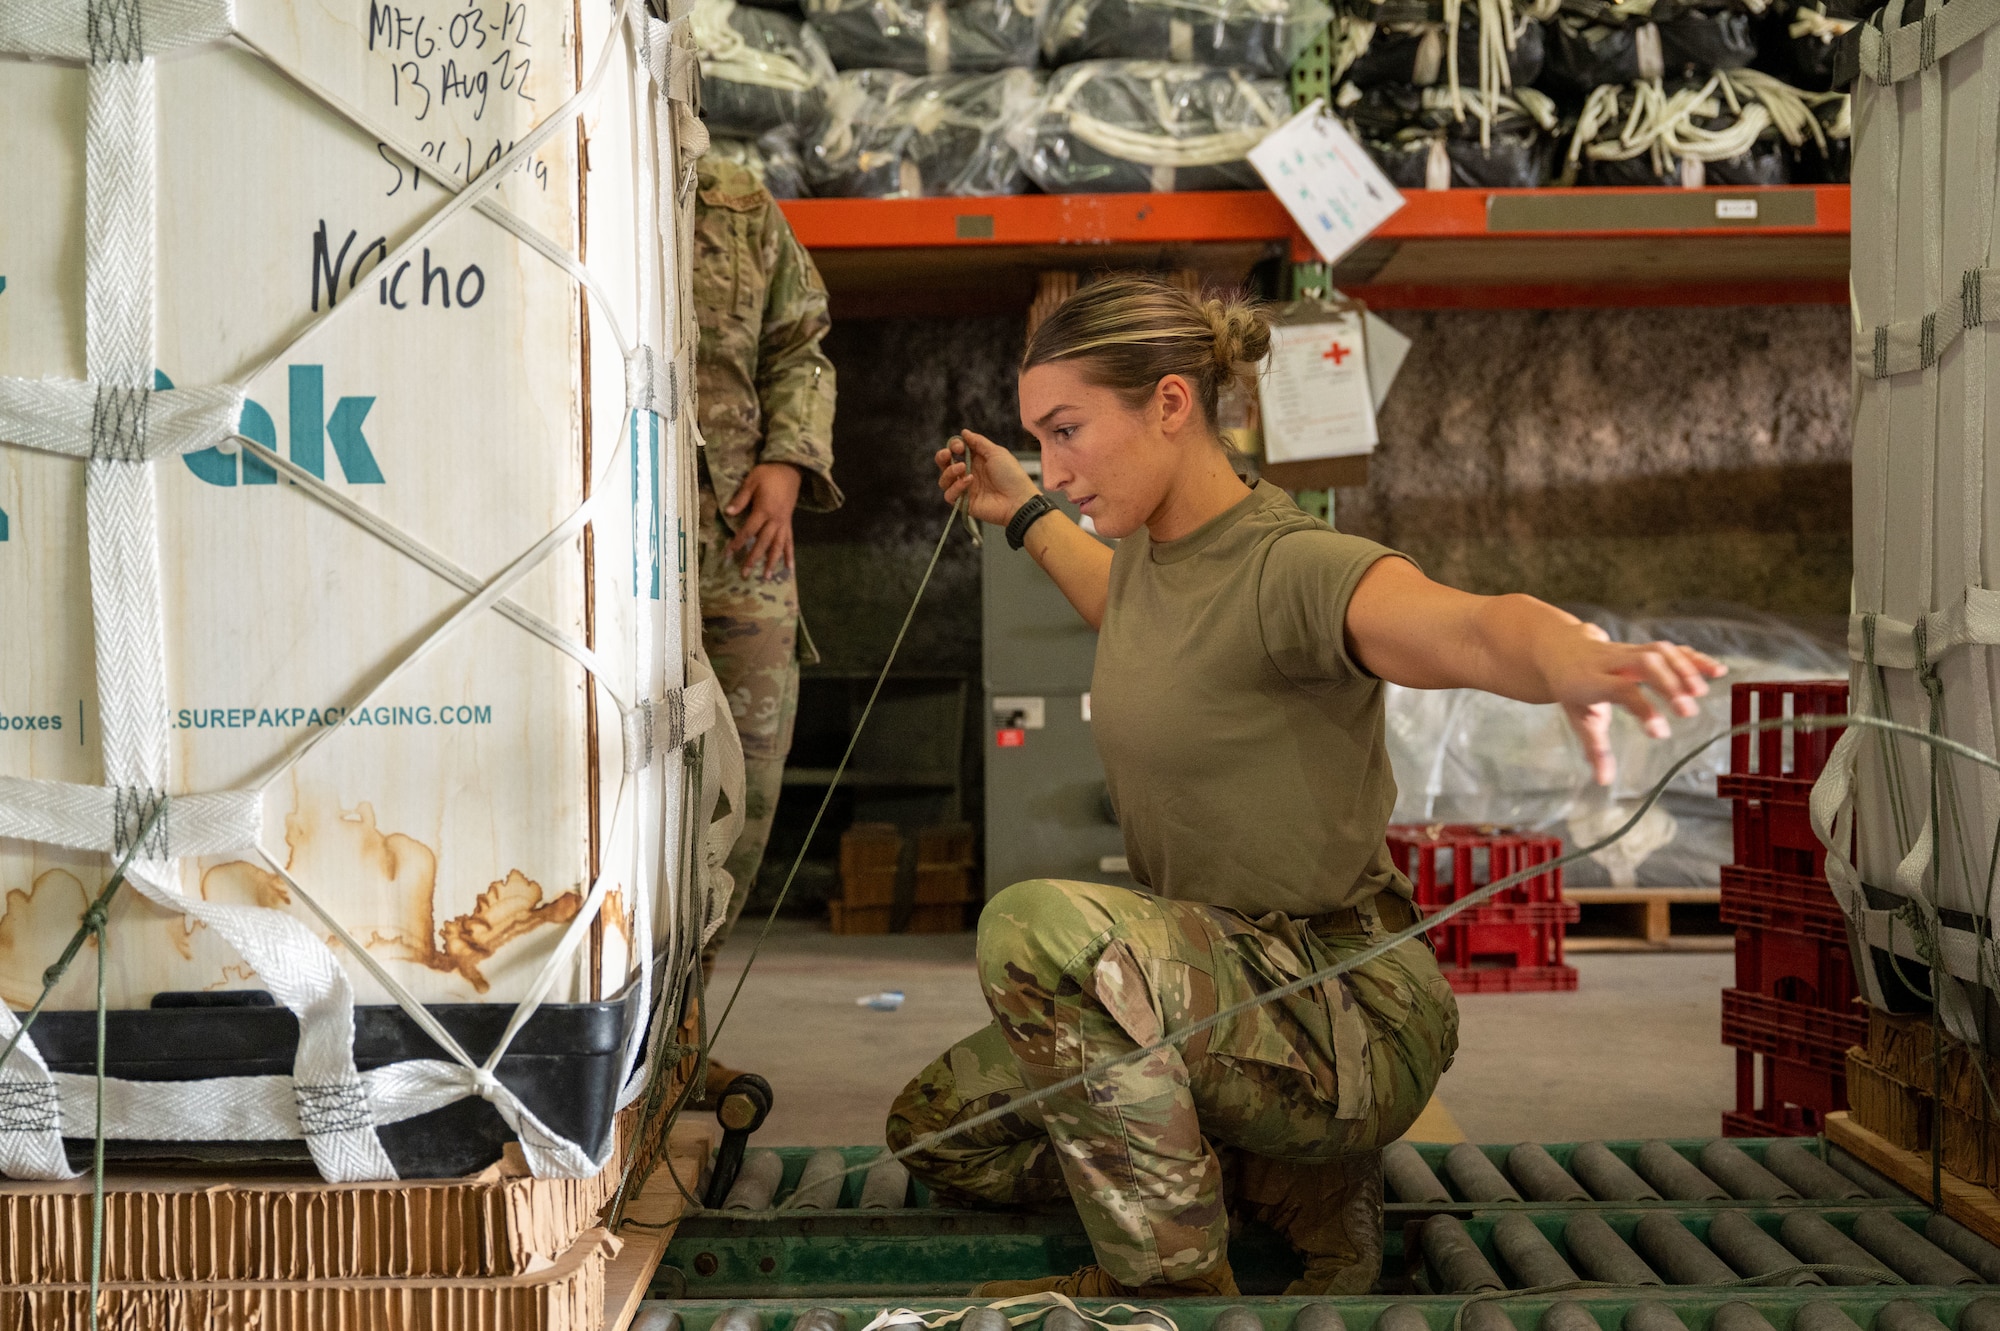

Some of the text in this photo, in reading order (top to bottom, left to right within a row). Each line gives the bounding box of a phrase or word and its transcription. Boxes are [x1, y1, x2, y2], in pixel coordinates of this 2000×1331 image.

[392, 49, 536, 121] 13 Aug 22
[311, 218, 486, 312] Nacho
[154, 364, 387, 487] ak
[166, 704, 492, 729] .SUREPAKPACAGING.COM
